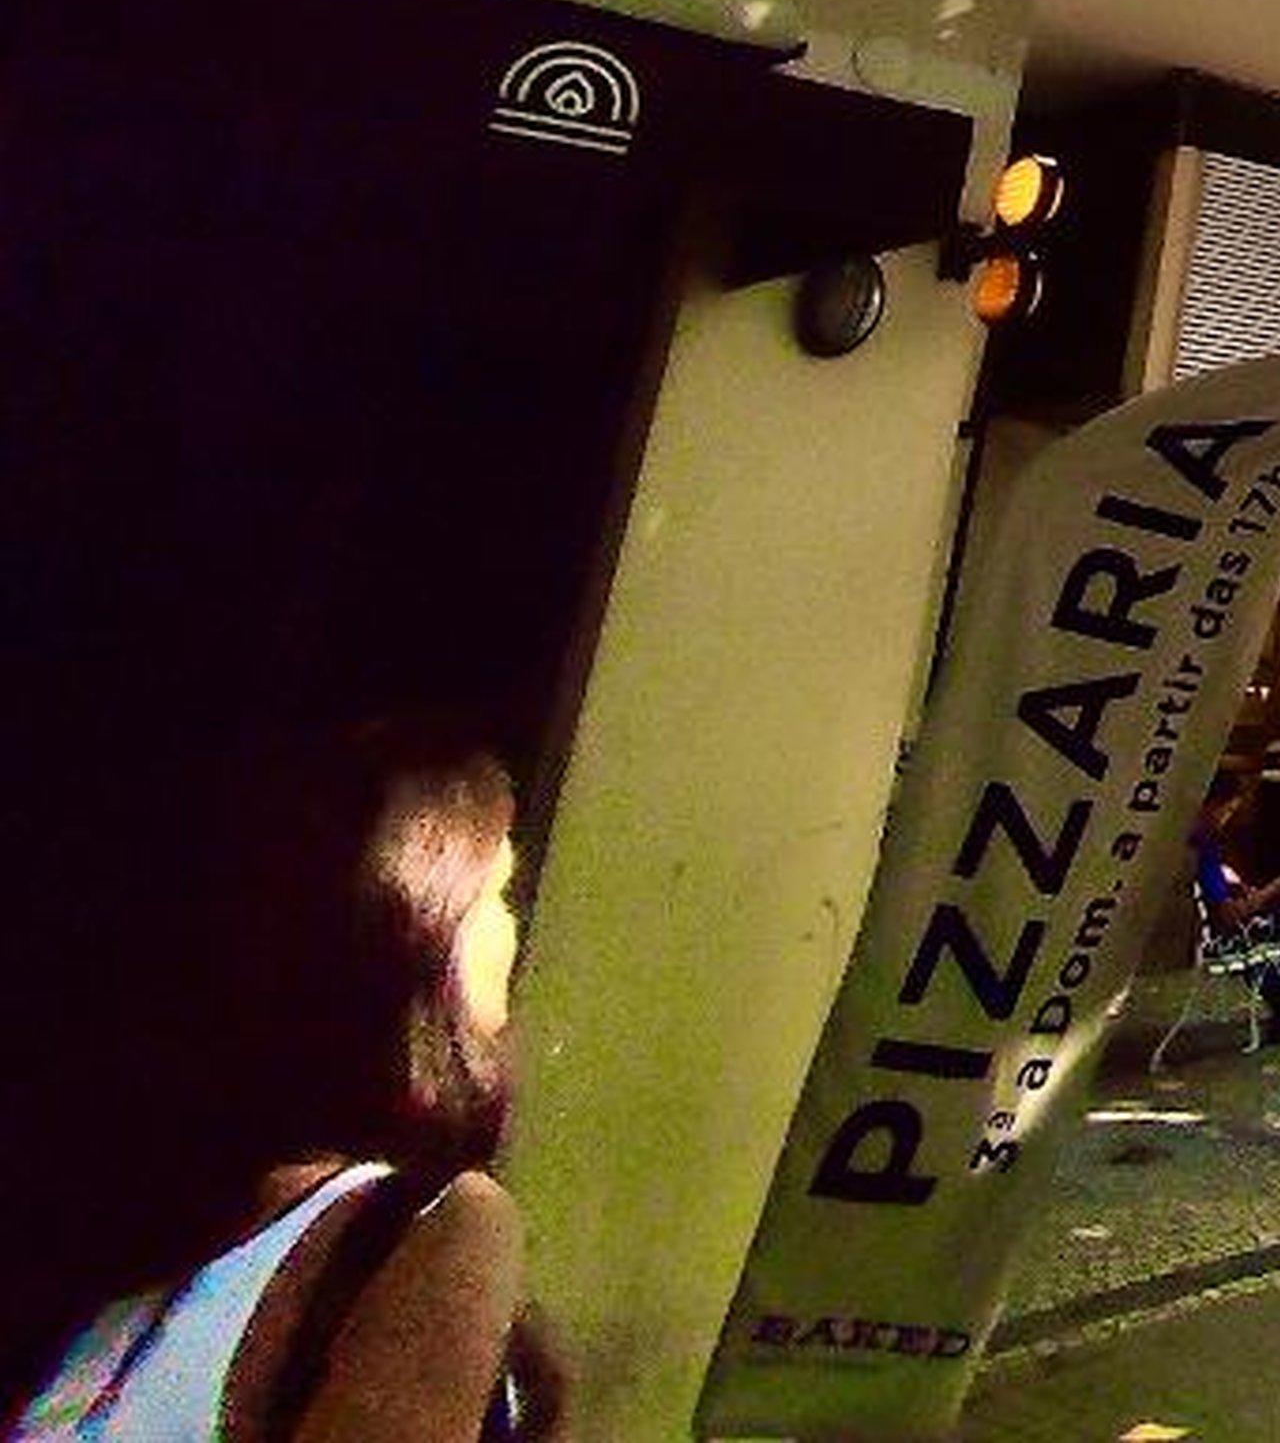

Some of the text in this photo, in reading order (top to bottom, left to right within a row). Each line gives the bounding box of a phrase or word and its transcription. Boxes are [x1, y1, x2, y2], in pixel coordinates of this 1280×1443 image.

[1192, 550, 1252, 640] das
[1127, 654, 1203, 813] partir
[807, 416, 1280, 1207] PIZZARIA
[1110, 831, 1143, 861] a
[1031, 879, 1123, 1034] Dom.
[1016, 1059, 1053, 1090] a
[749, 1316, 971, 1357] BAKED
